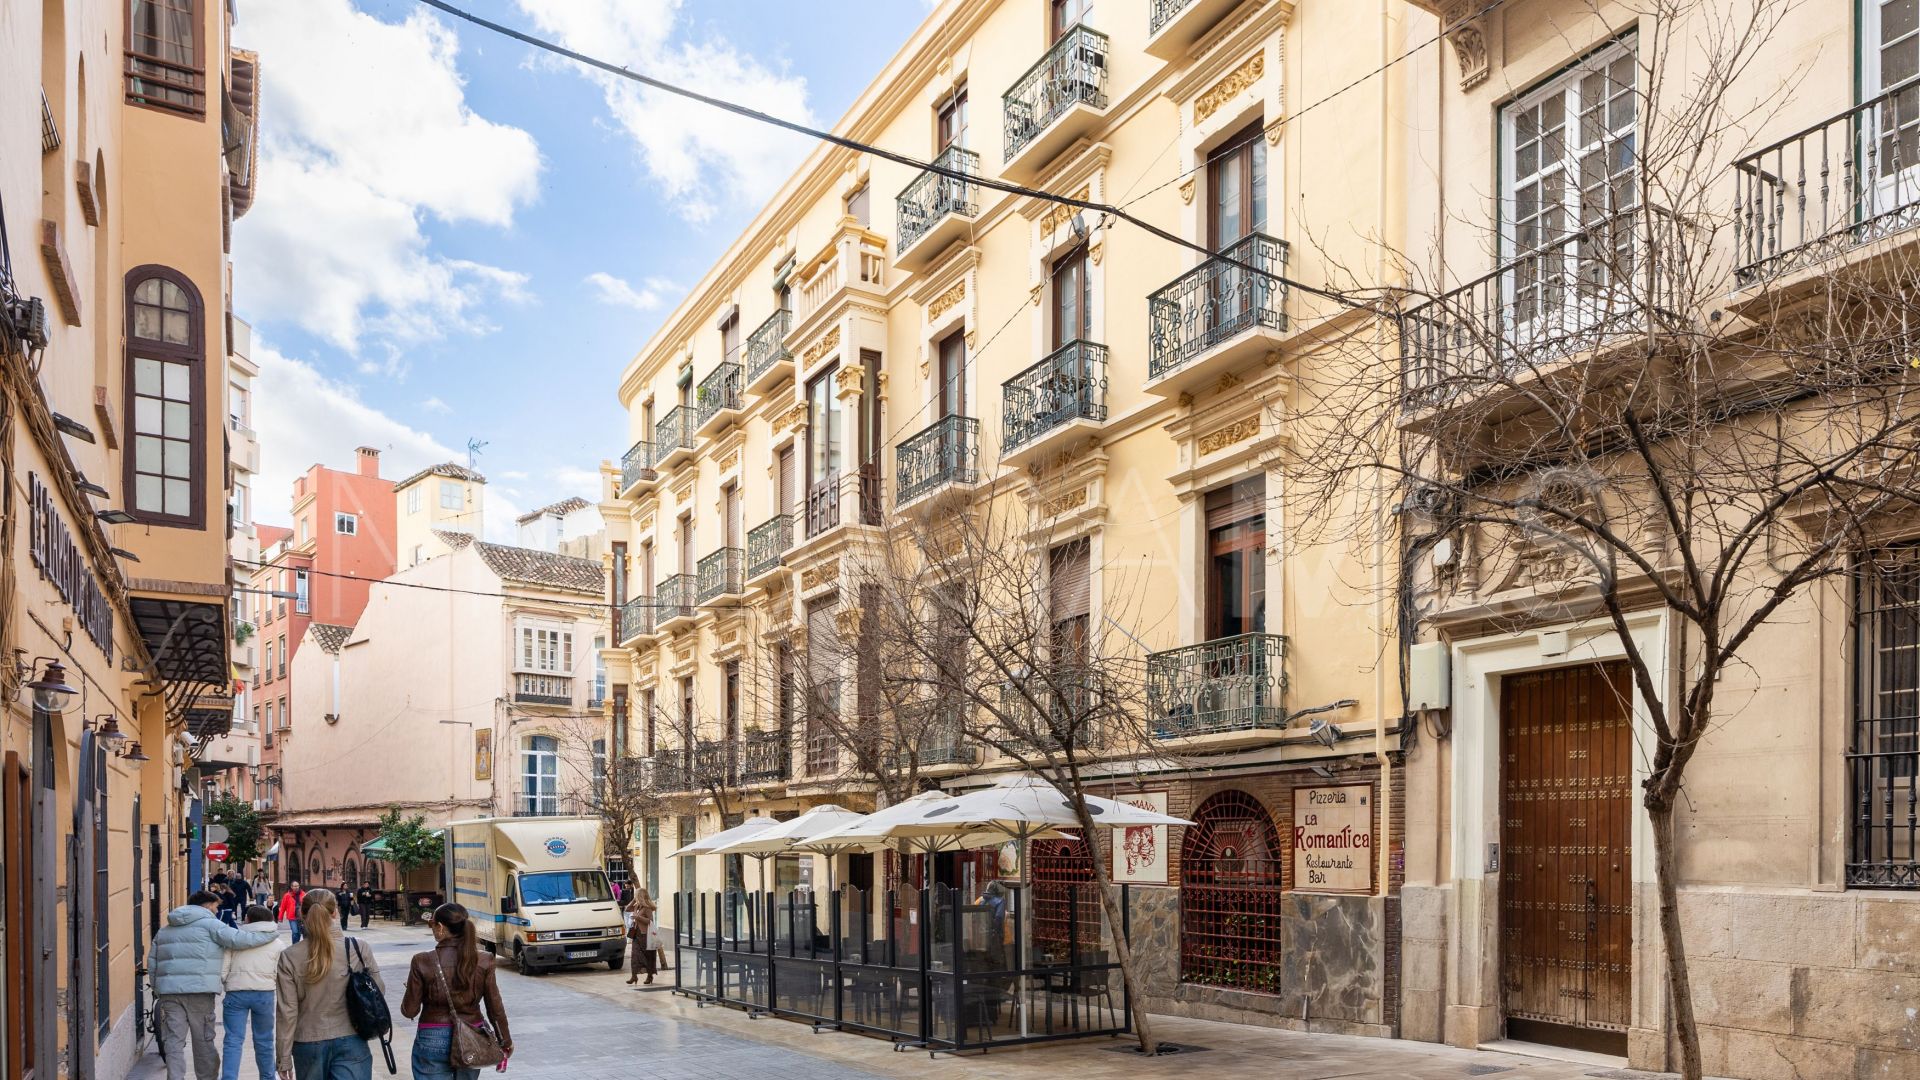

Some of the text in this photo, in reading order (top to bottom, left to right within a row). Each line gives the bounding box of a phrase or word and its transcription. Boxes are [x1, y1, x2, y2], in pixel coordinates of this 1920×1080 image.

[1309, 790, 1346, 804] Pizzeria
[1306, 853, 1353, 869] Restaurante
[1309, 870, 1326, 884] Bar
